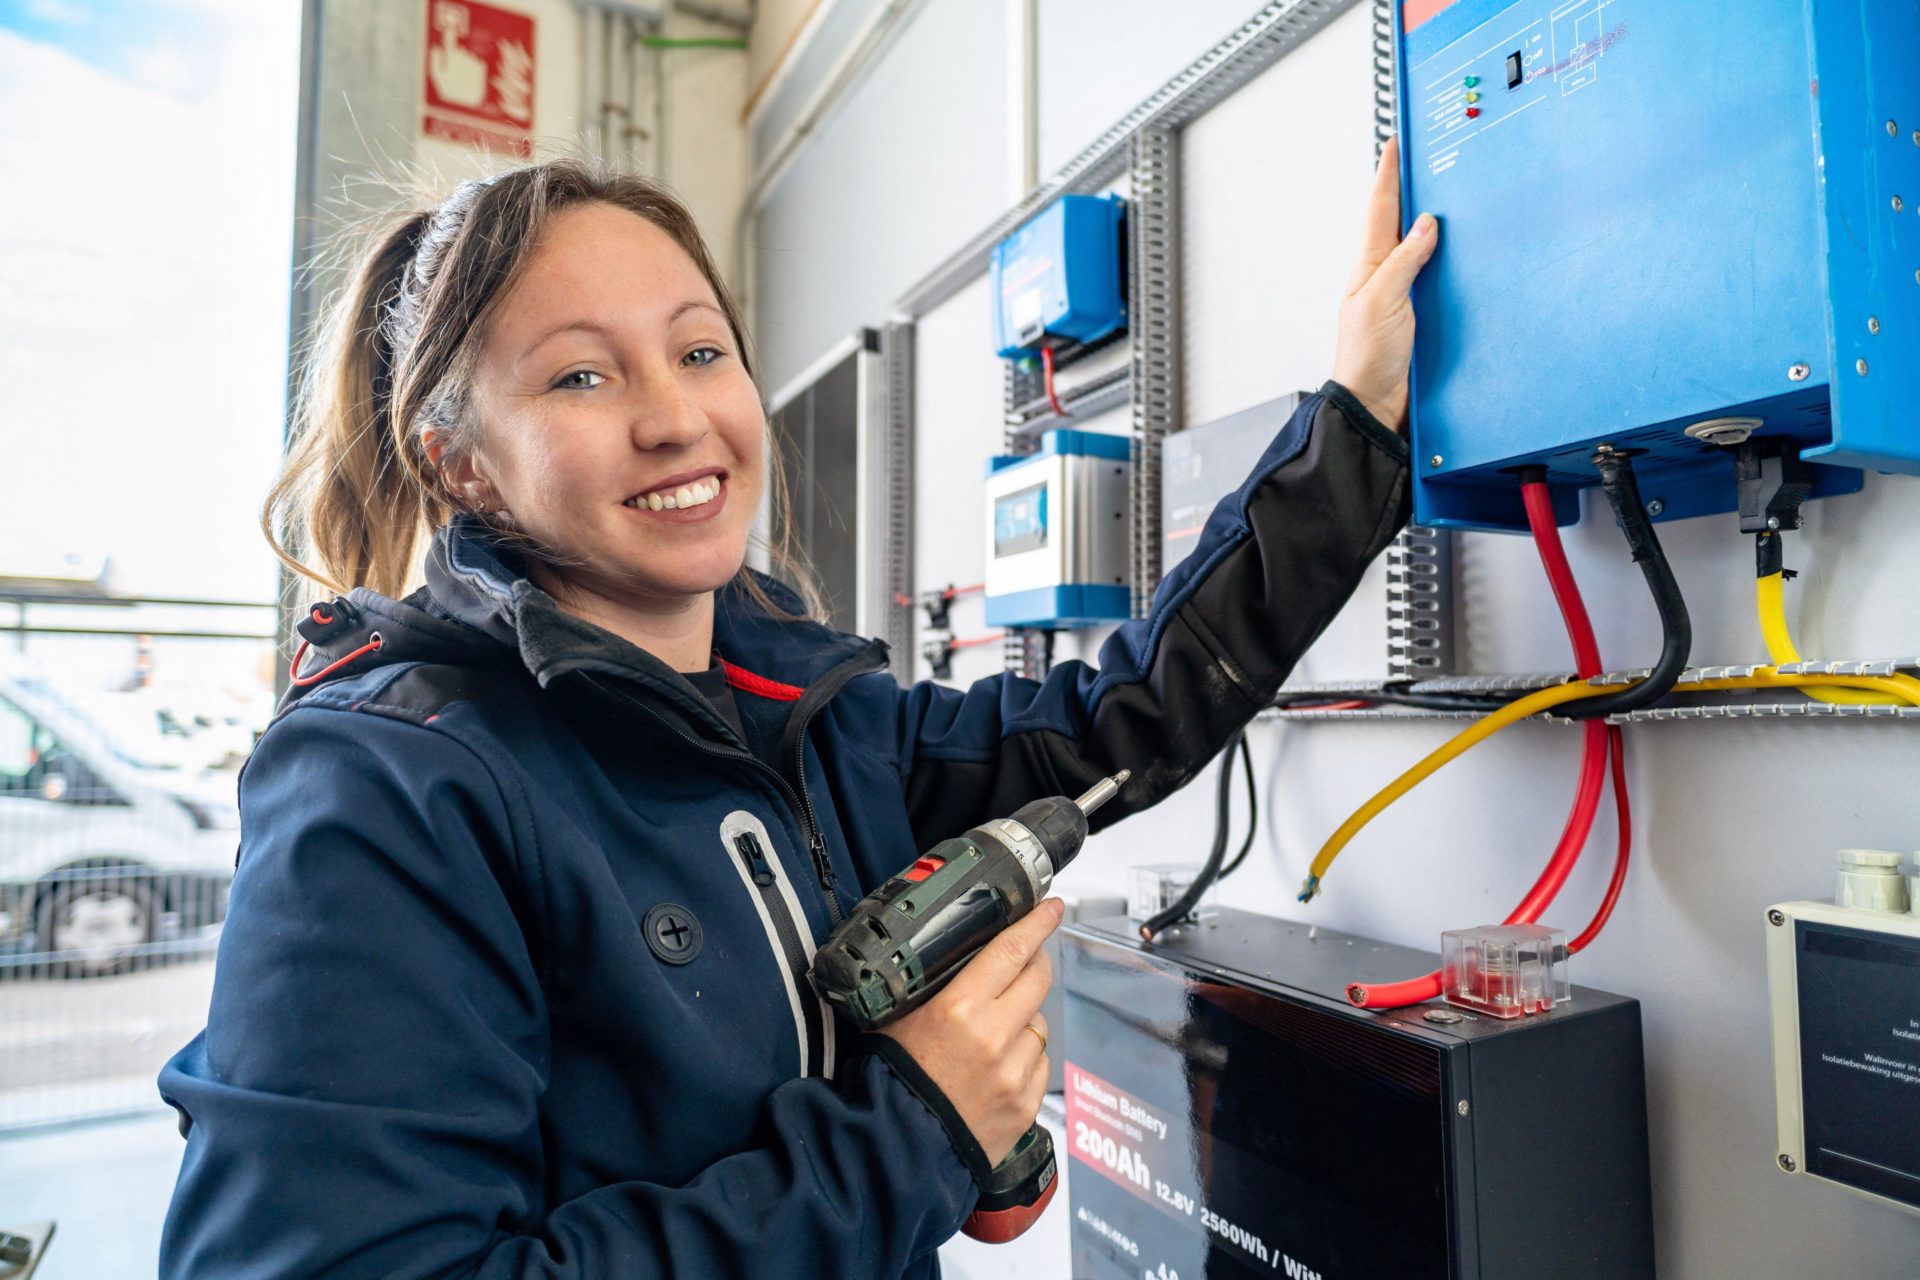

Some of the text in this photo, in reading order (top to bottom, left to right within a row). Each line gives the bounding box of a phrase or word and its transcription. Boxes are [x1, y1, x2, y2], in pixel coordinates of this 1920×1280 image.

[1822, 1053, 1891, 1078] Isolatiebewaking
[1864, 1053, 1906, 1070] Walinvoer
[1908, 1063, 1916, 1072] in
[1073, 1072, 1167, 1140] Lithium Battery
[1075, 1121, 1151, 1191] 200Ah
[1155, 1180, 1195, 1216] 12.8V
[1200, 1207, 1268, 1262] 2560Wh
[1272, 1249, 1280, 1269] /
